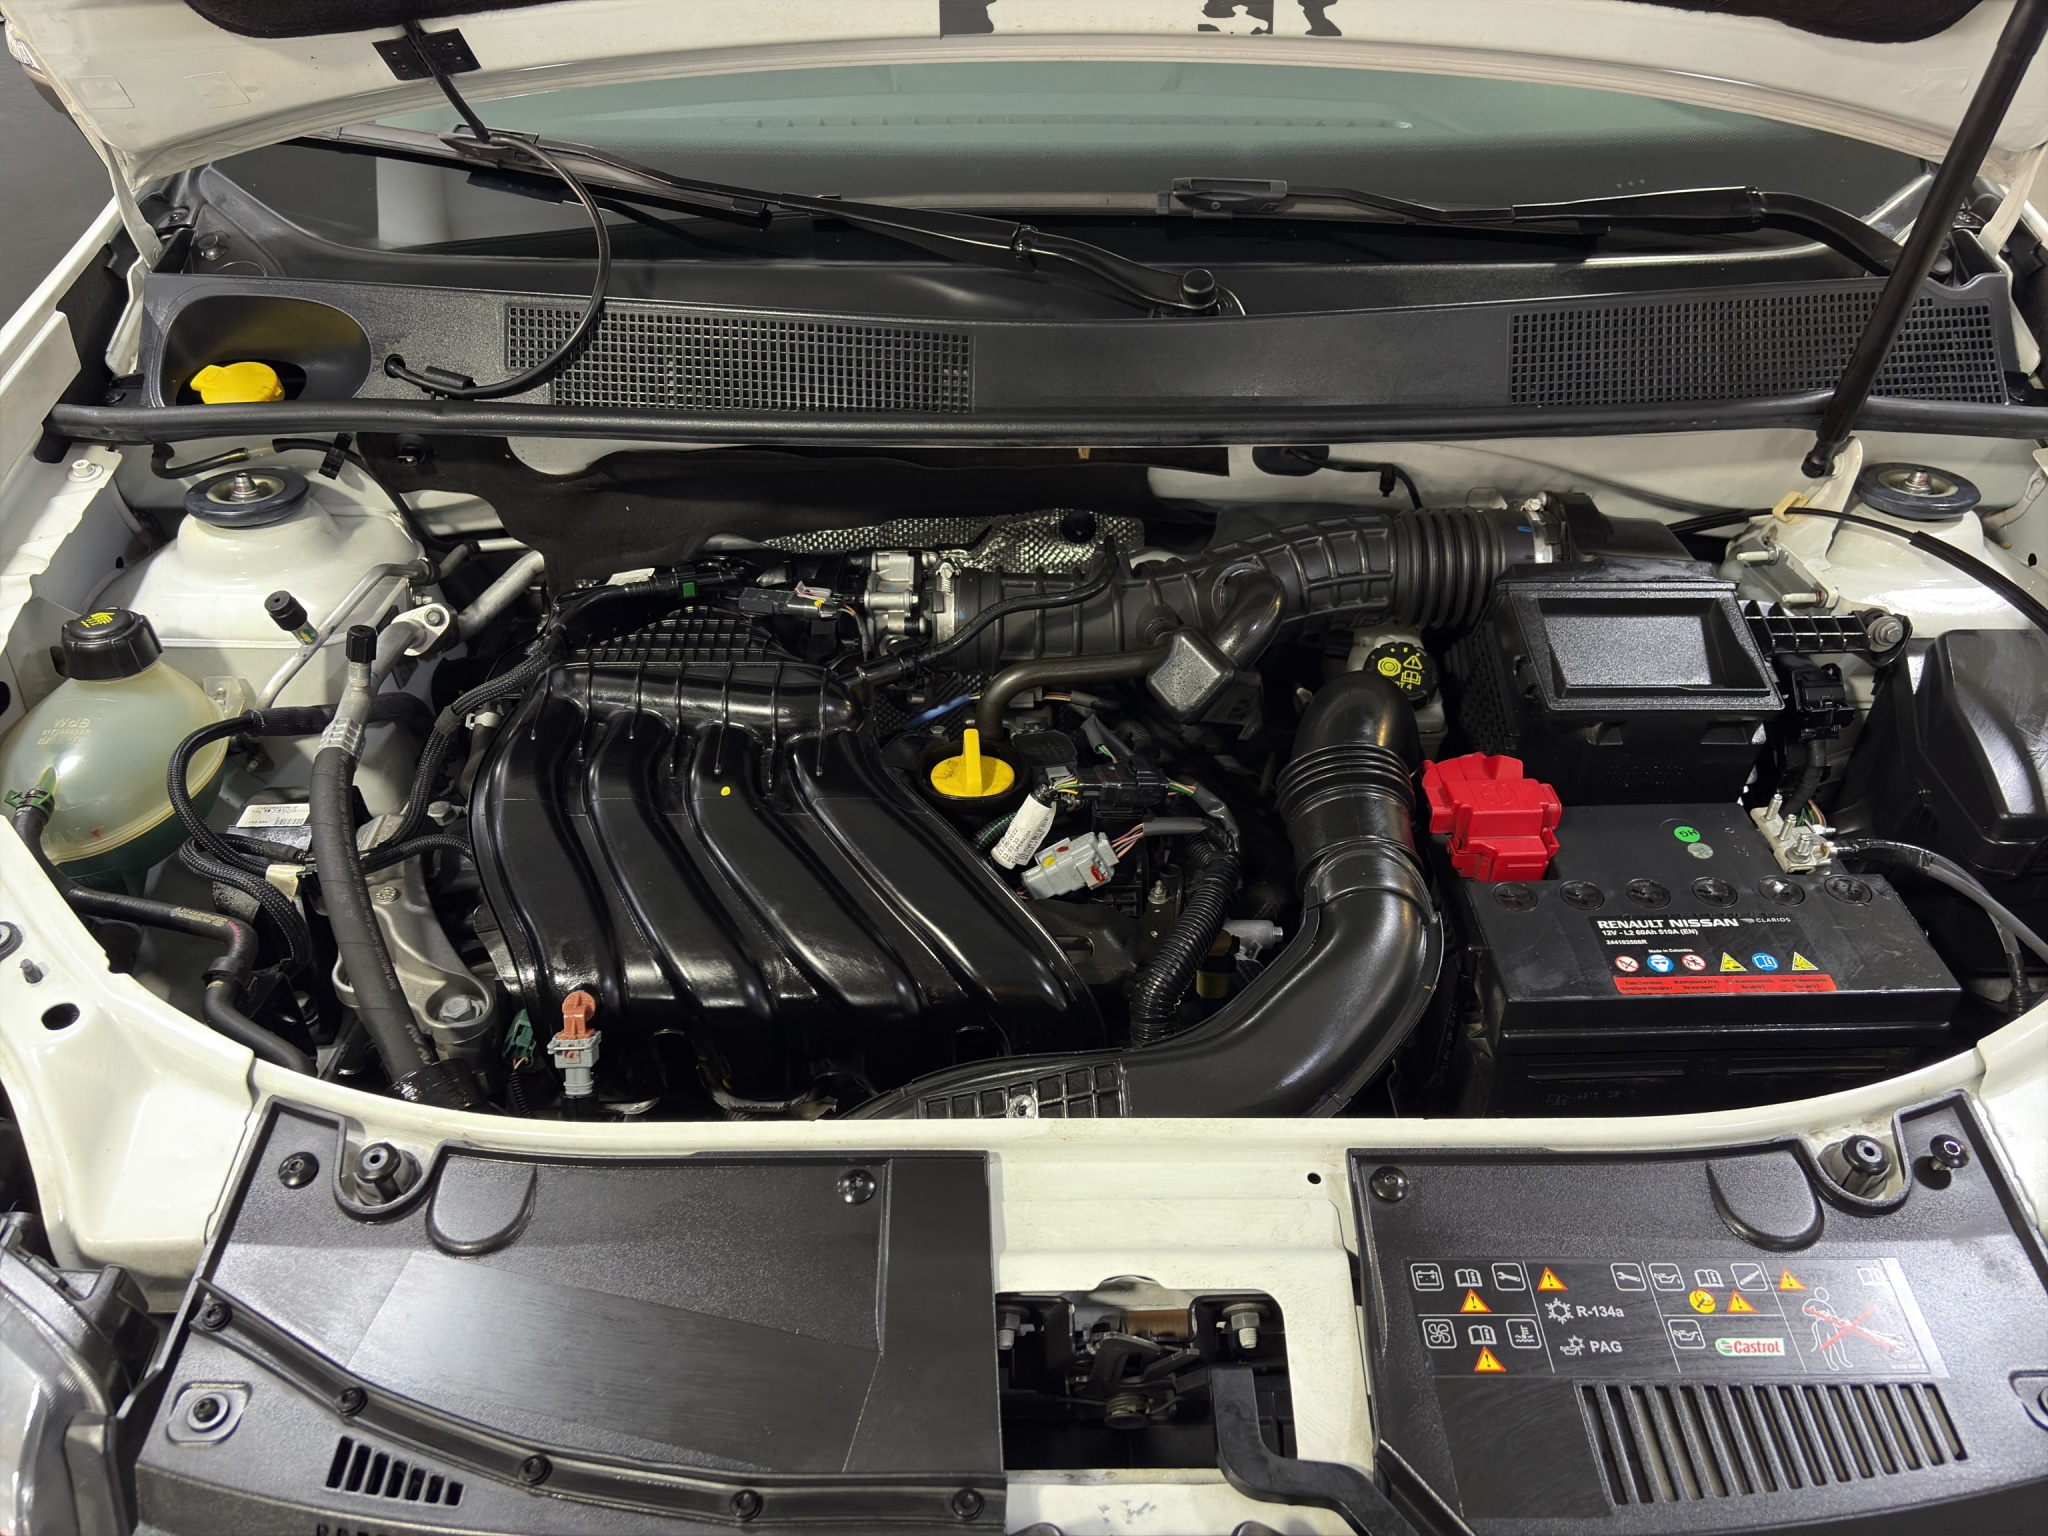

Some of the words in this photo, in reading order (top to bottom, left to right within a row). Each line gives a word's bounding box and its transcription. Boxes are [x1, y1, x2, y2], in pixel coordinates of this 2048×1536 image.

[1597, 920, 1664, 929] RENAULT
[1669, 919, 1739, 928] NISSAN
[1680, 928, 1698, 936] (EN)
[1576, 1305, 1625, 1318] R-134a
[1590, 1340, 1622, 1353] PAG
[1734, 1340, 1781, 1353] Castrol
